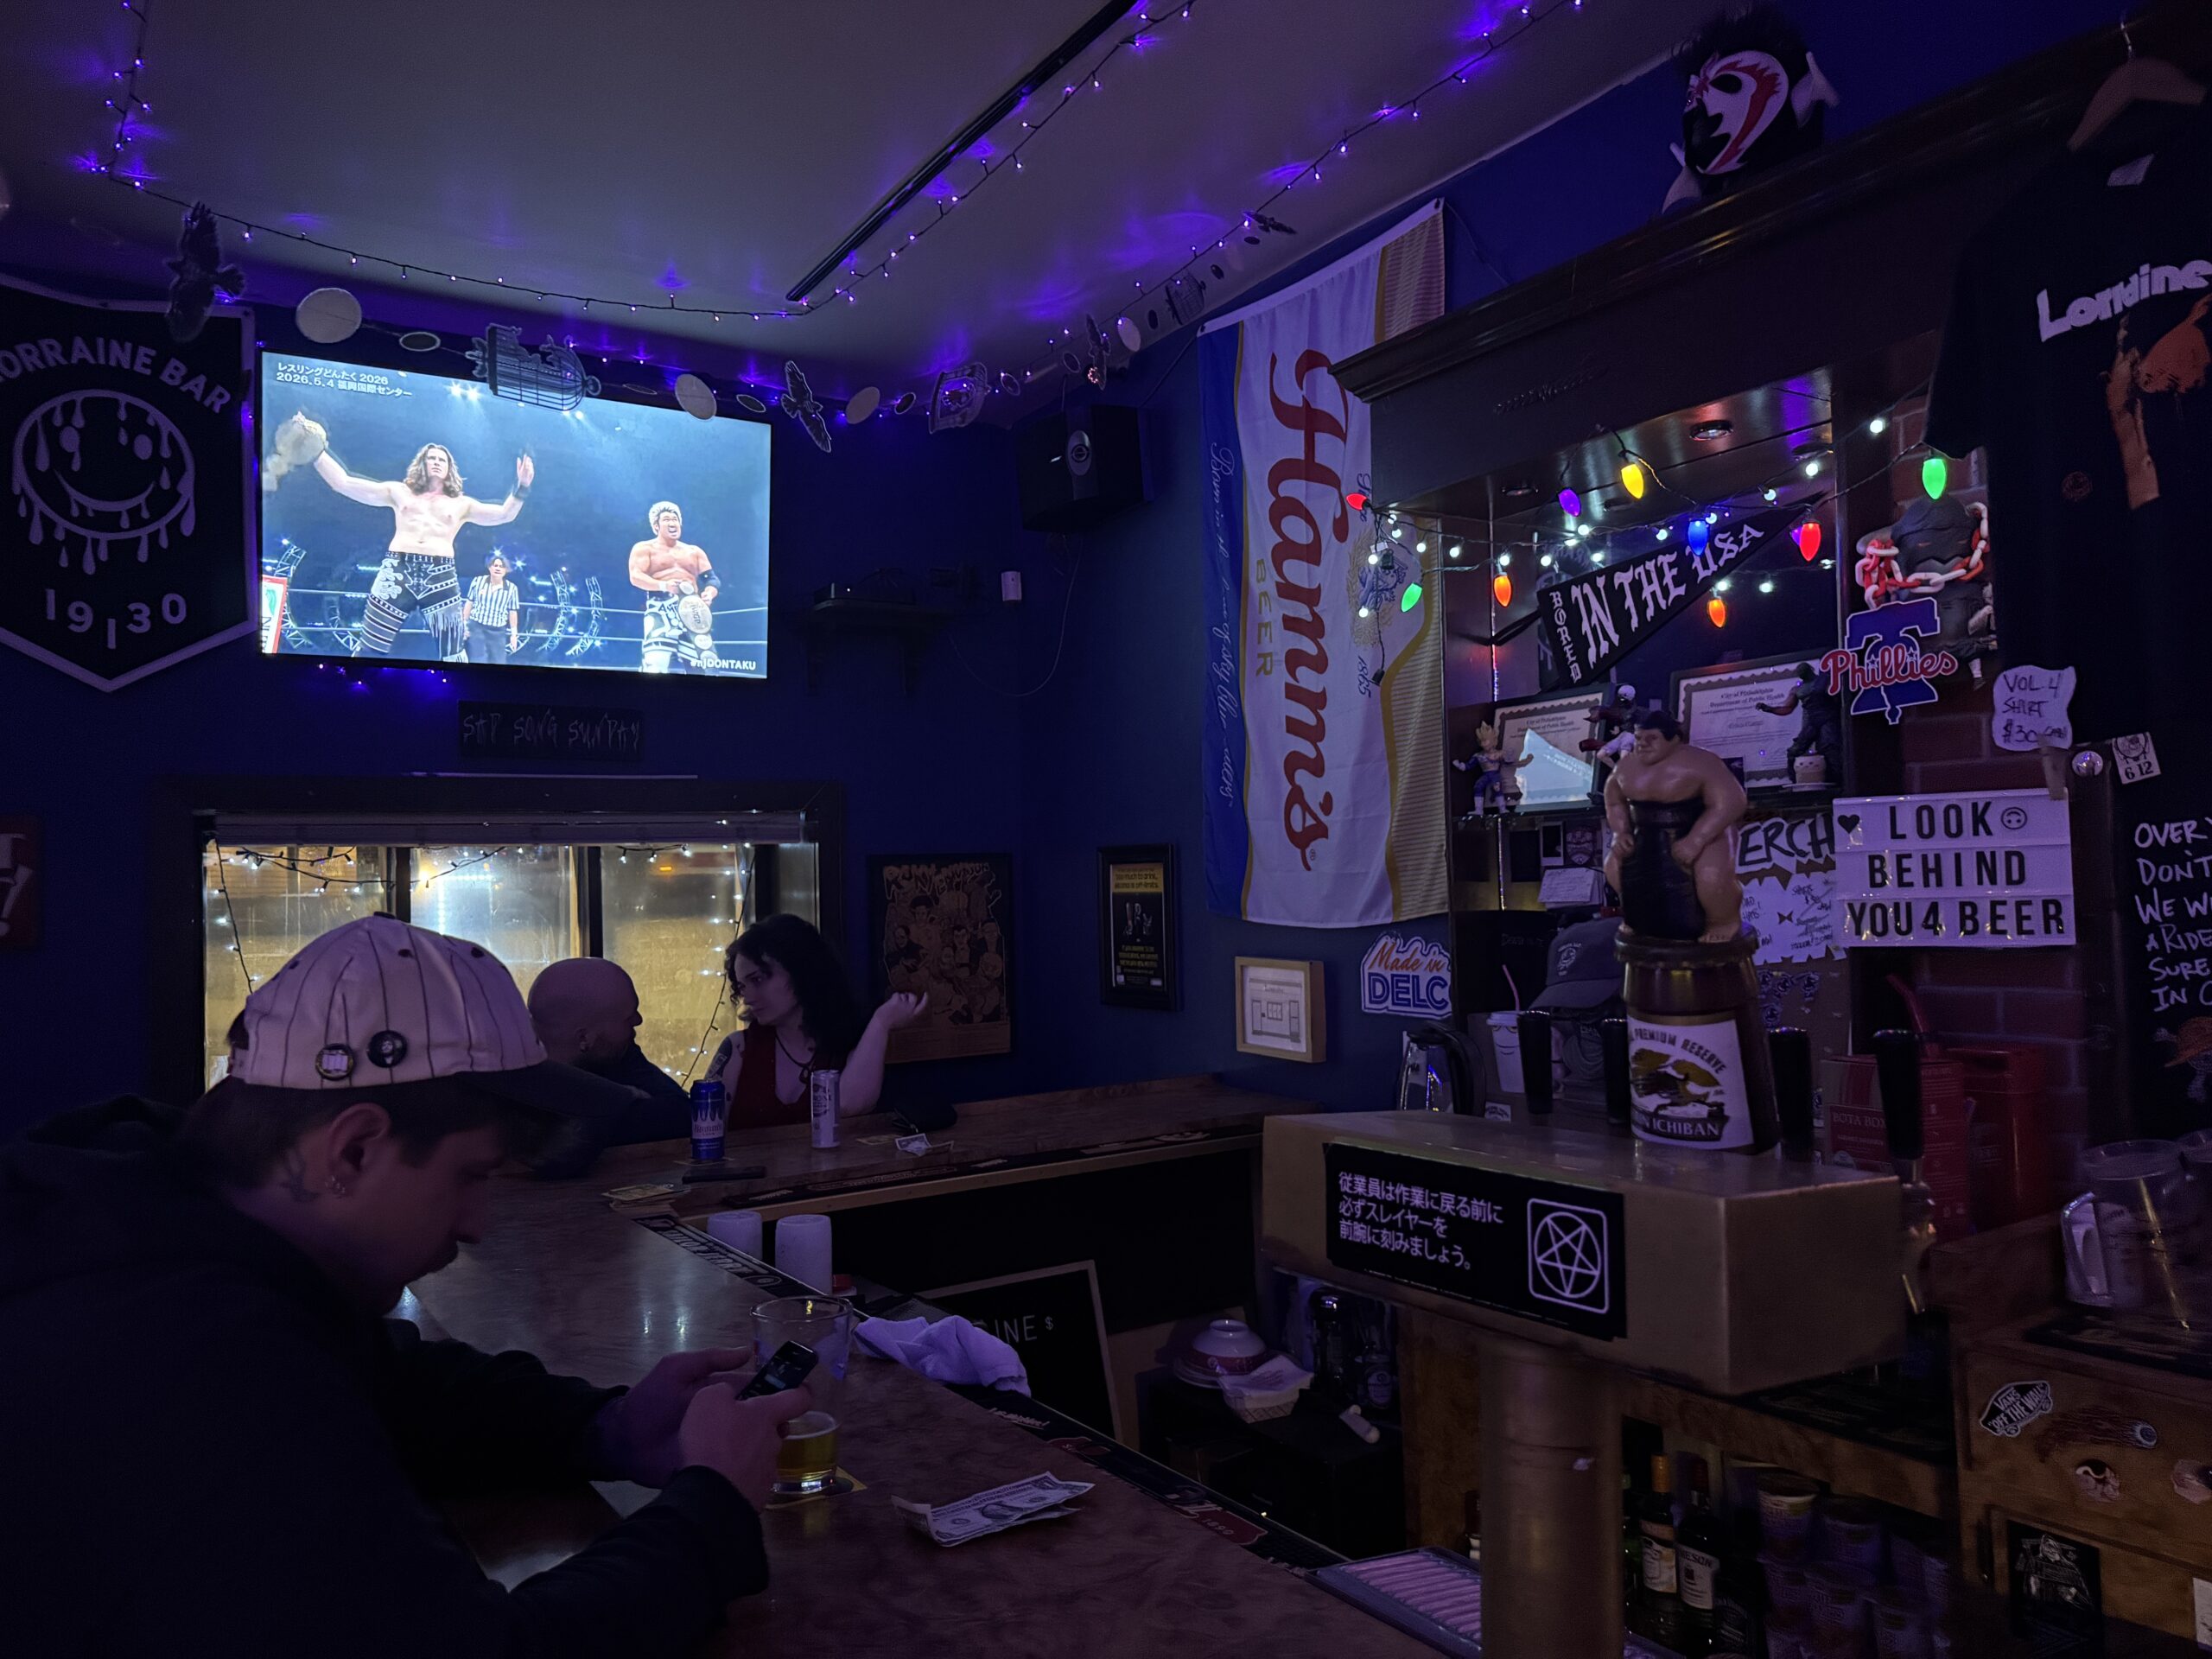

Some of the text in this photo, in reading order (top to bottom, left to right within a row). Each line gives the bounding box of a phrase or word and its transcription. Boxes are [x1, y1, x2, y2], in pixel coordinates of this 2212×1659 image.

[0, 335, 232, 414] ORRAINE BAR
[276, 372, 334, 388] 2026.5.4
[277, 362, 389, 385] レスリングどんたく 2026
[1266, 348, 1349, 872] Hamm's
[1571, 524, 1765, 669] IN THE USA
[1255, 558, 1274, 677] BEER
[1548, 590, 1583, 684] BORED
[1211, 645, 1236, 683] sky
[1357, 656, 1371, 699] 1865
[1820, 644, 1959, 696] Phillies
[2124, 760, 2154, 780] 6 12
[1738, 813, 1836, 867] ERCH
[1890, 801, 1993, 840] LOOK
[2134, 819, 2209, 849] OVER
[1867, 850, 2026, 889] BEHIND
[2136, 849, 2212, 887] DON'T
[1959, 897, 2066, 937] BEER
[2134, 887, 2176, 925] WE
[1368, 942, 1447, 973] Made in
[2145, 923, 2212, 954] A RIDE
[2148, 956, 2211, 982] SURE
[1368, 972, 1449, 1011] DELC
[2151, 984, 2189, 1013] IN
[1681, 1038, 1726, 1074] RESERVE
[1652, 1117, 1719, 1136] ICHIBAN
[1338, 1171, 1505, 1225] 従業員は作業に戻る前に
[1338, 1195, 1450, 1241] 必ずスレイヤーを
[1338, 1218, 1473, 1272] 前腕に刻みましょう。
[1993, 1387, 2021, 1412] VANS
